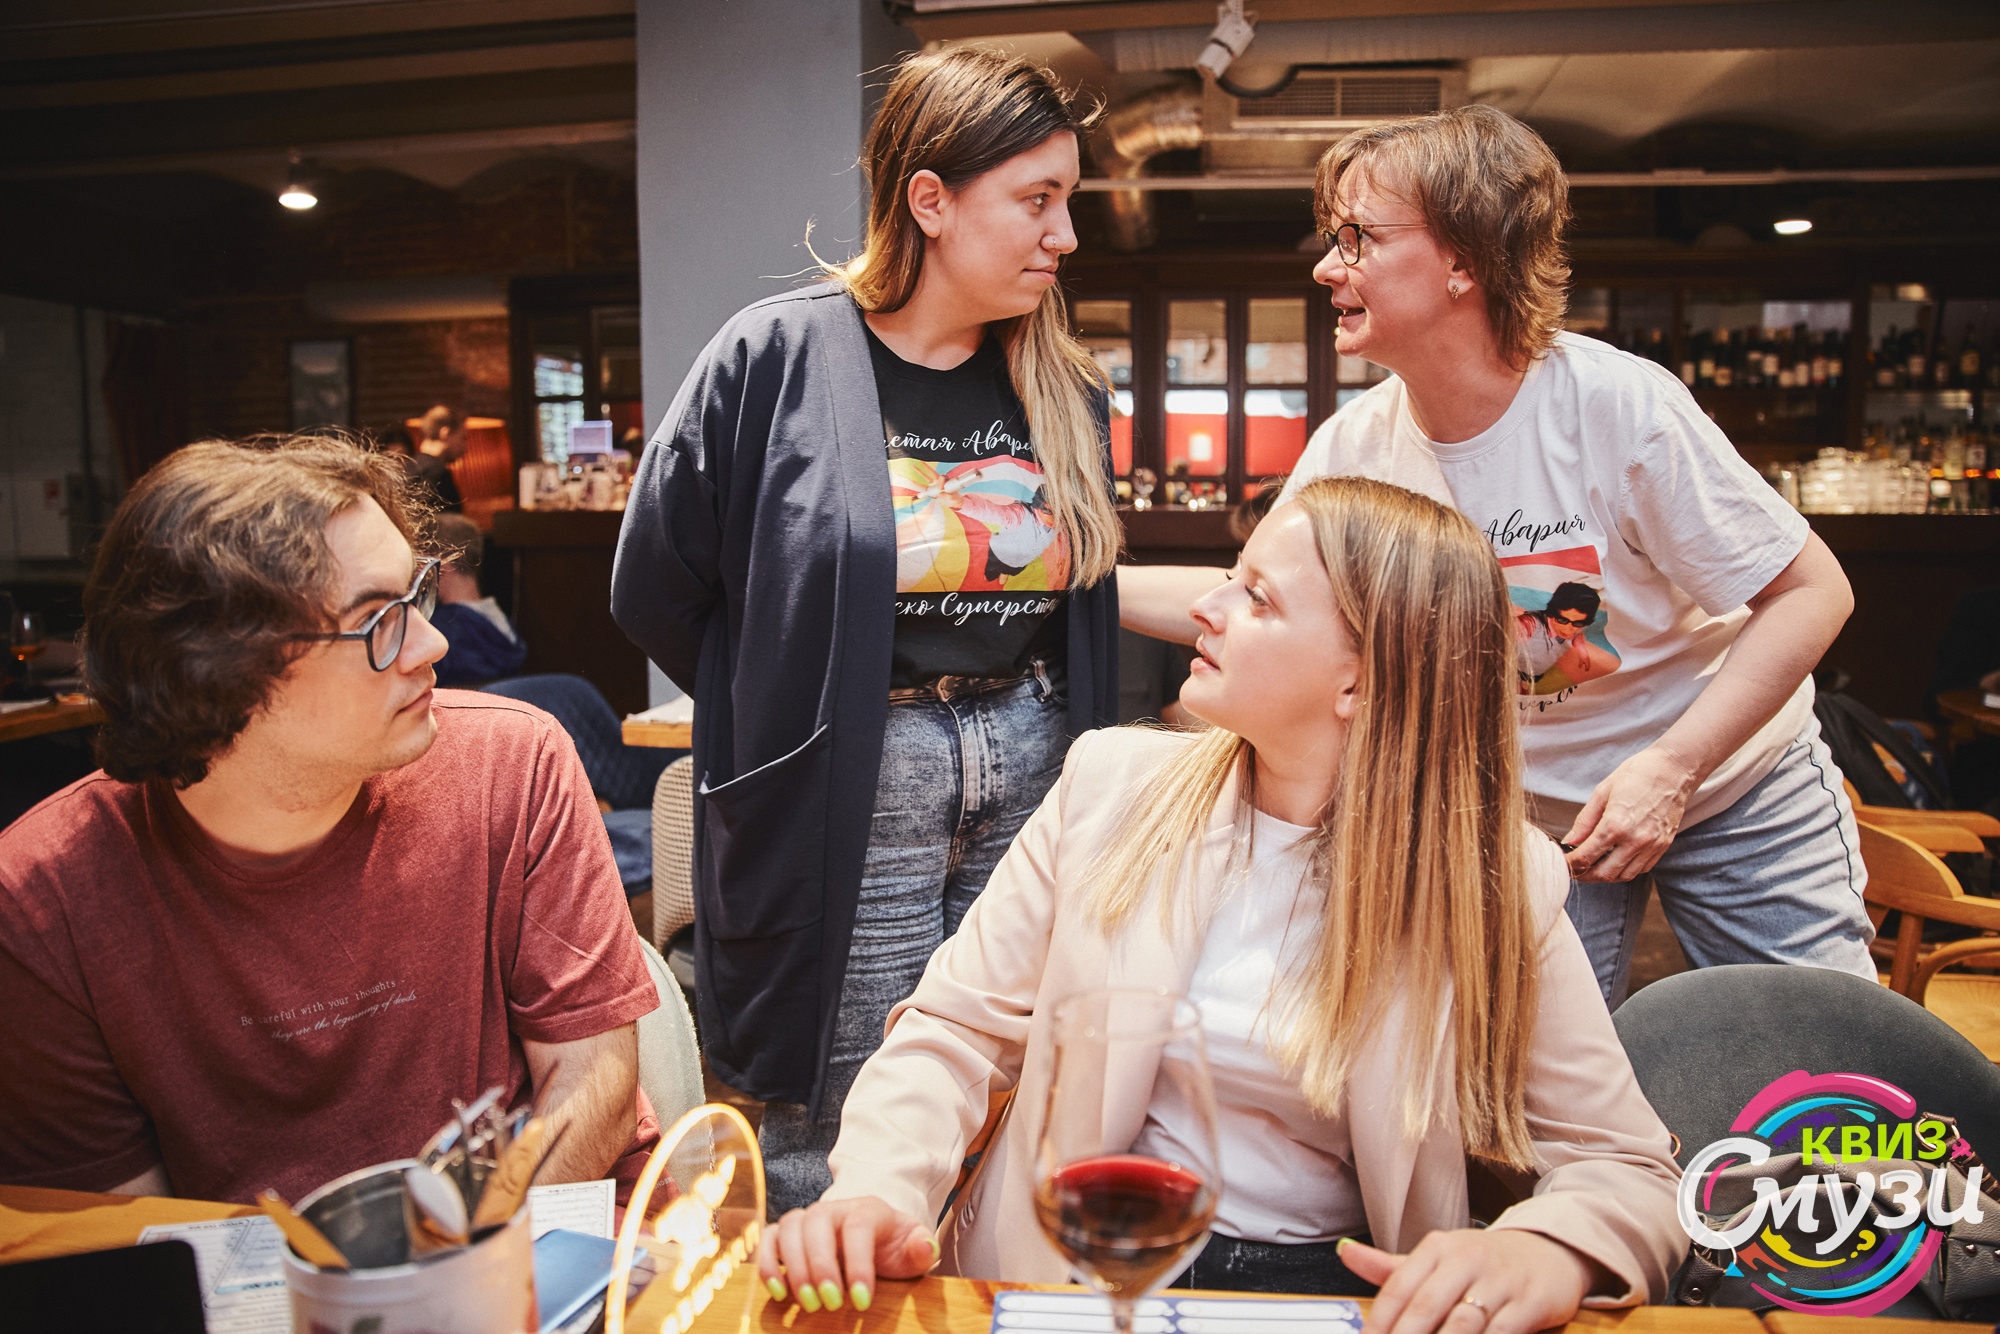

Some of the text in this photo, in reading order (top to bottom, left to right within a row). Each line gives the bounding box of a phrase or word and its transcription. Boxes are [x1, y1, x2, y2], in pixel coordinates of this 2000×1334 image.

[885, 419, 1035, 456] етая Авари
[1482, 508, 1587, 553] Авария
[895, 592, 1058, 627] ско Суперст
[240, 1015, 254, 1027] Be
[258, 1008, 297, 1024] careful
[300, 1001, 325, 1016] with
[328, 996, 350, 1011] your
[355, 980, 398, 1001] thoughts
[314, 1016, 331, 1031] the
[381, 993, 396, 1013] of
